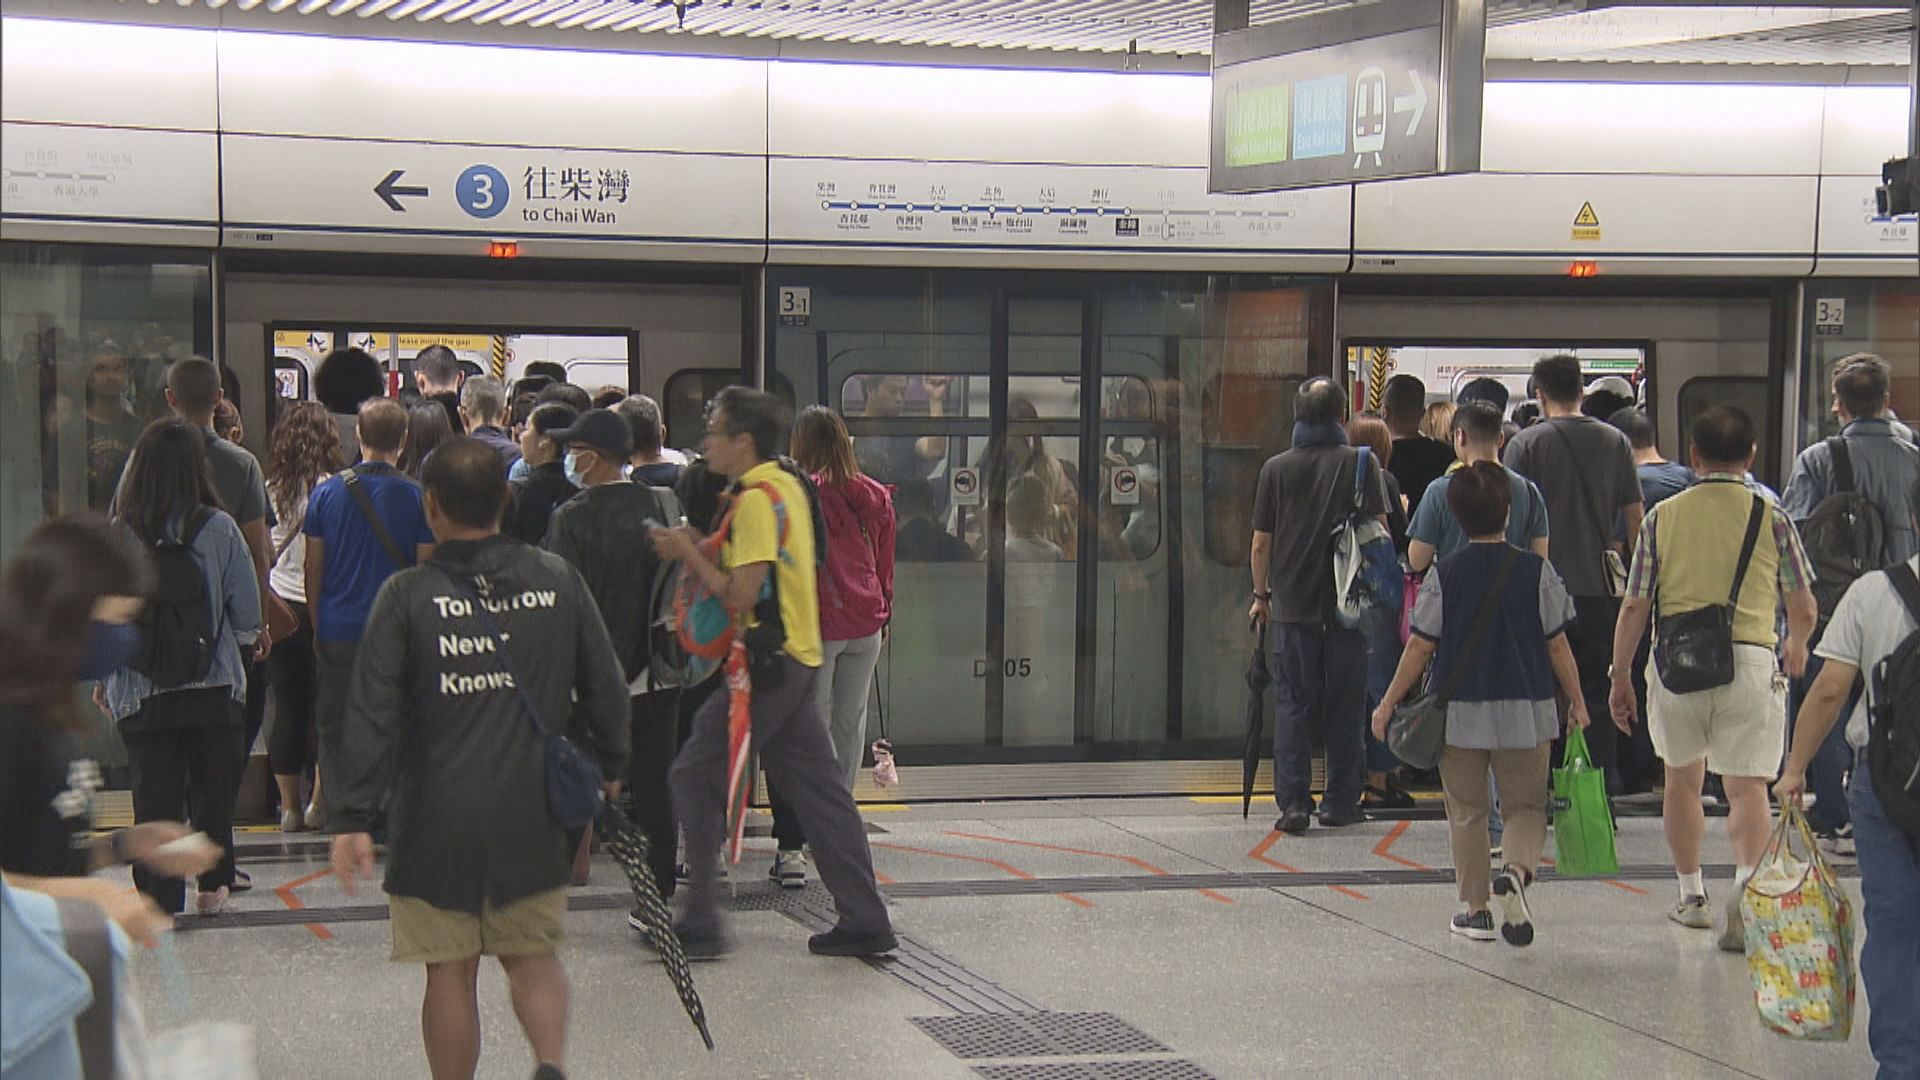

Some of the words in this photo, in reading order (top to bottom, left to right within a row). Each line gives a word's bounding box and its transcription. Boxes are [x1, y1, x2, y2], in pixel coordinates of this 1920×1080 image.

[472, 173, 494, 210] 3
[523, 166, 631, 203] 往柴灣
[523, 208, 539, 222] to
[543, 208, 578, 222] Chai
[581, 208, 616, 224] Wan
[399, 336, 418, 345] lease
[974, 657, 1031, 678] D05
